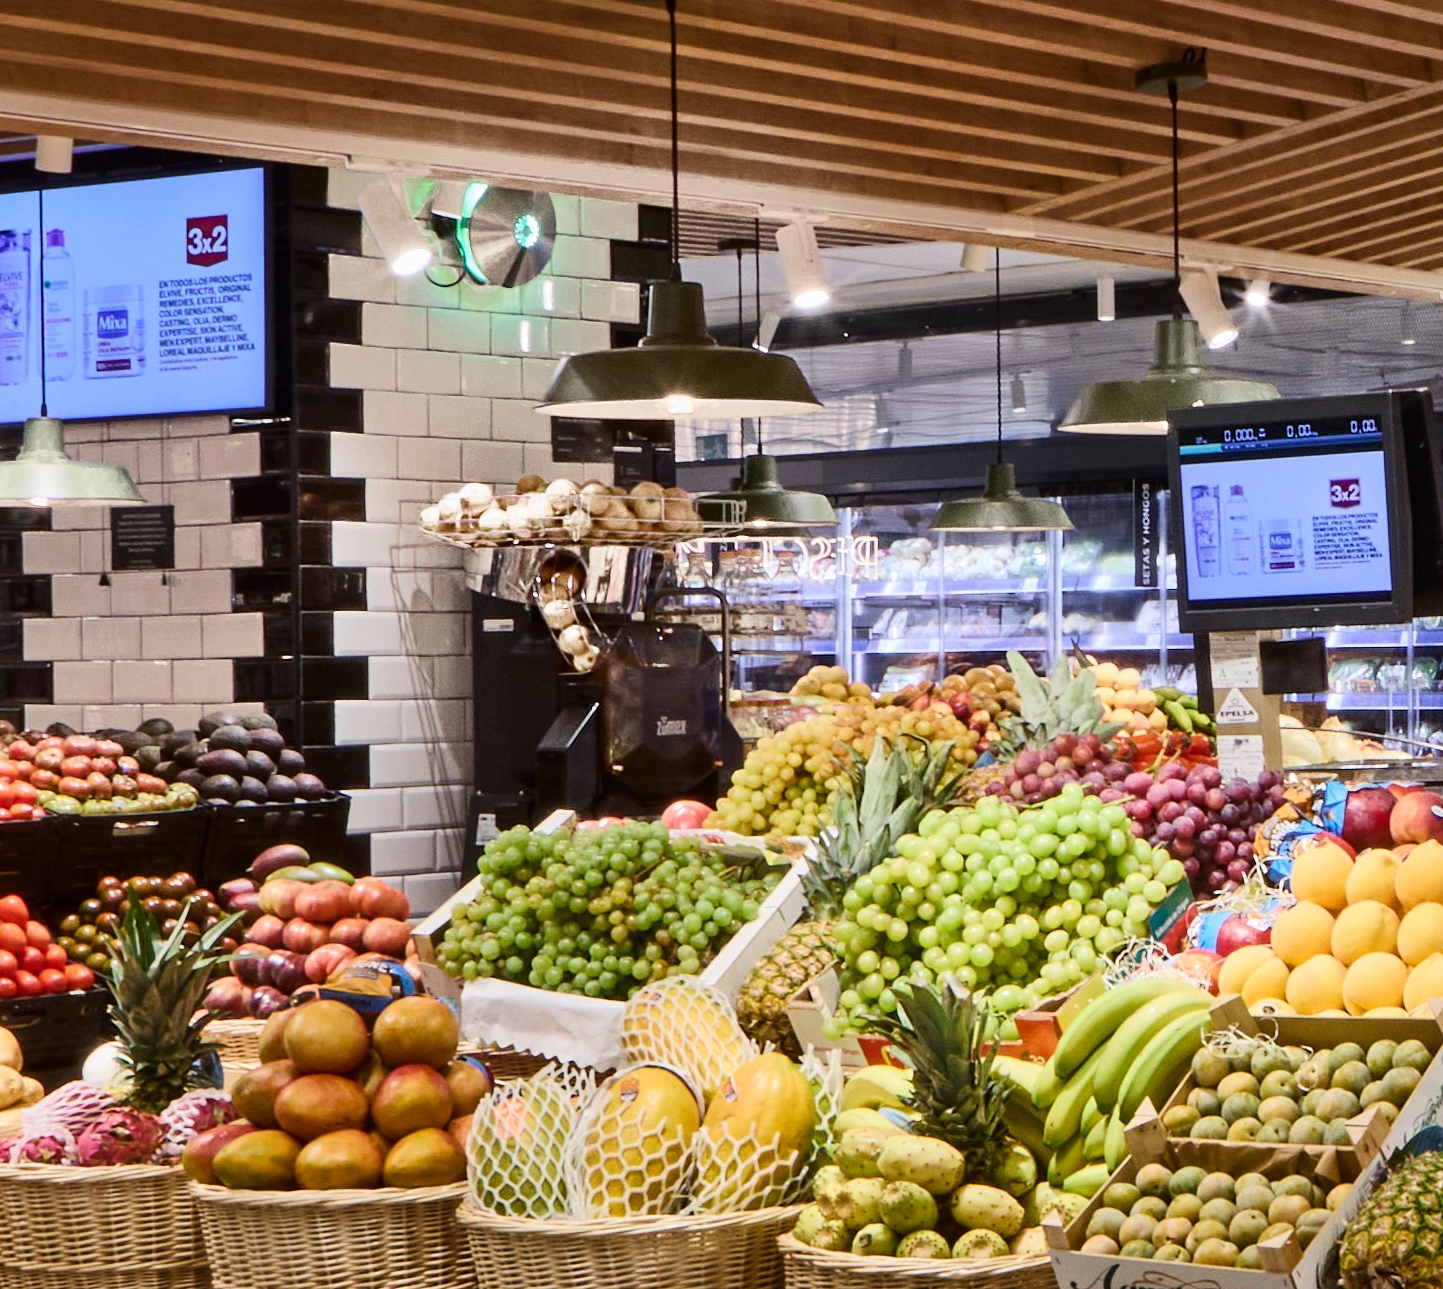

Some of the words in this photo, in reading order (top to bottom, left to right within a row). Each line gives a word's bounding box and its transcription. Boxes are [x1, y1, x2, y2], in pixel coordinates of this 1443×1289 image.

[187, 225, 227, 255] 3x2
[99, 314, 127, 330] Mixa
[1331, 484, 1360, 503] 3x2
[1142, 483, 1151, 535] HONGOS
[1142, 537, 1151, 546] Y
[1142, 548, 1151, 586] SETAS
